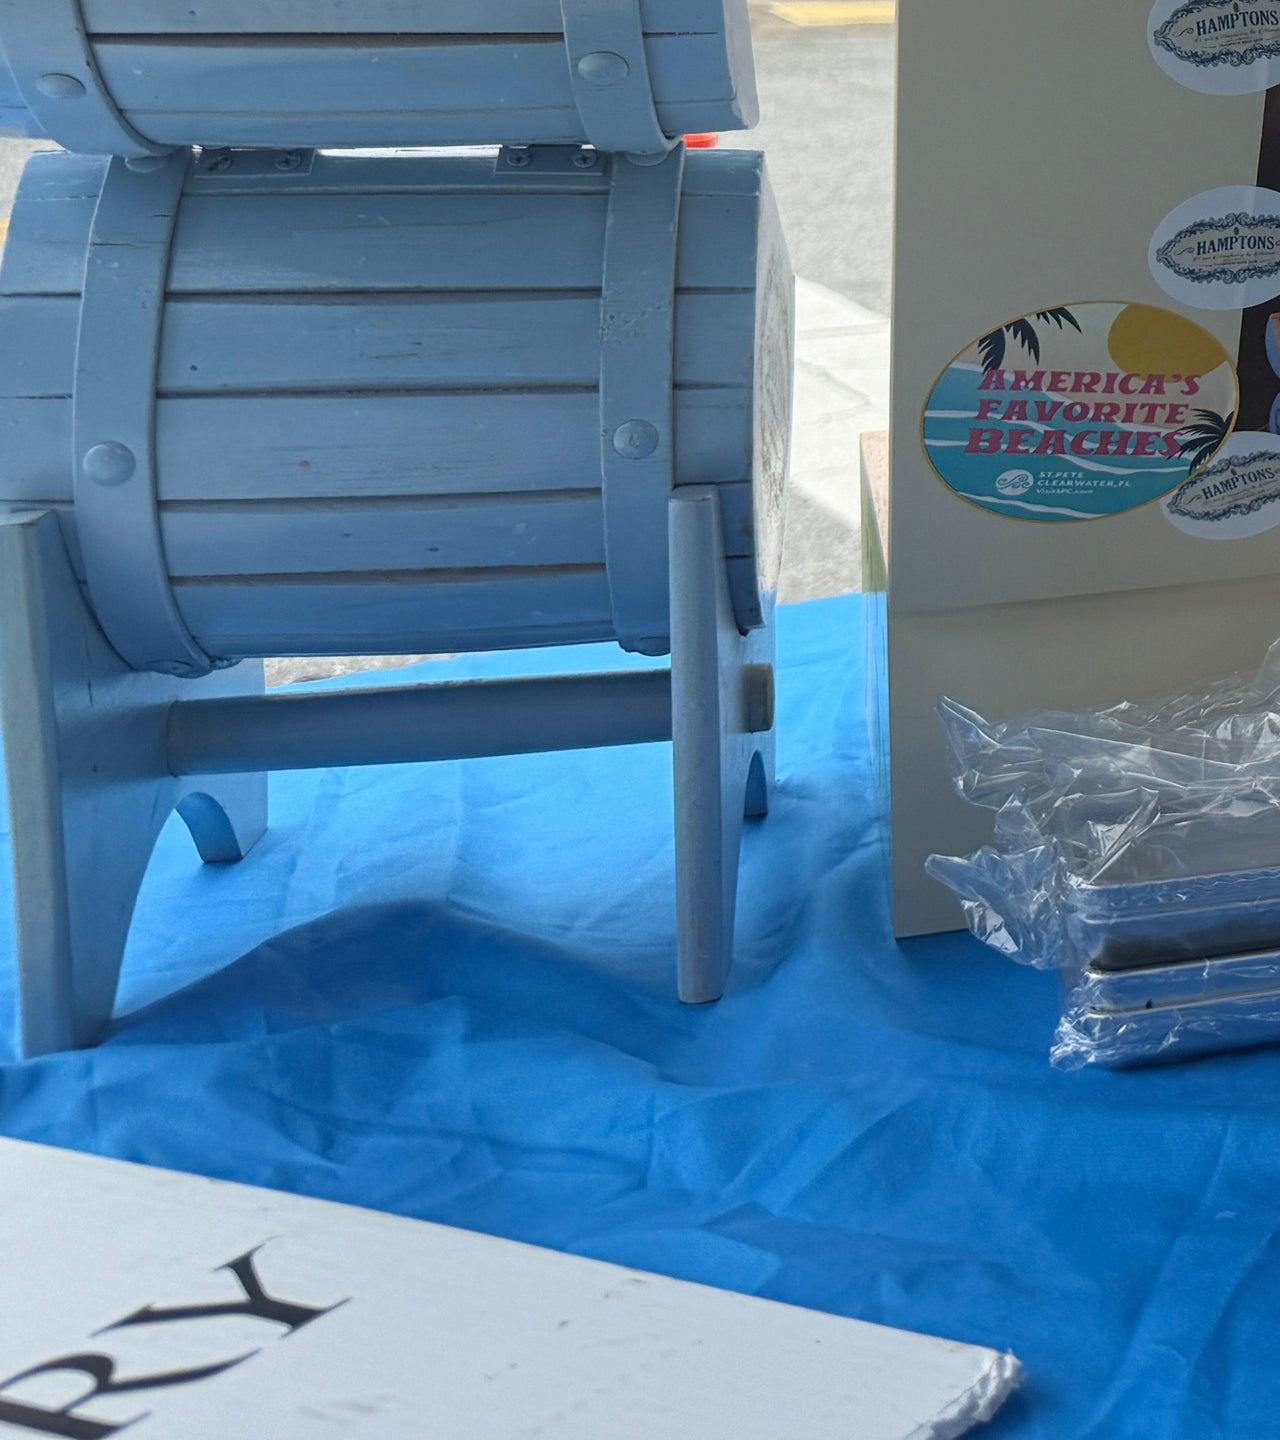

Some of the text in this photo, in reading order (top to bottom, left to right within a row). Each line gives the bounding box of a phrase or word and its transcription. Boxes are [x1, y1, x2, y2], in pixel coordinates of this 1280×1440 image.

[1196, 10, 1279, 37] HAMPTONS
[1197, 235, 1275, 256] HAMPTONS
[977, 369, 1202, 396] AMERICA'S
[975, 399, 1192, 425] FAVORITE
[964, 428, 1190, 457] BEACHES
[1202, 467, 1276, 500] HAMPTONS
